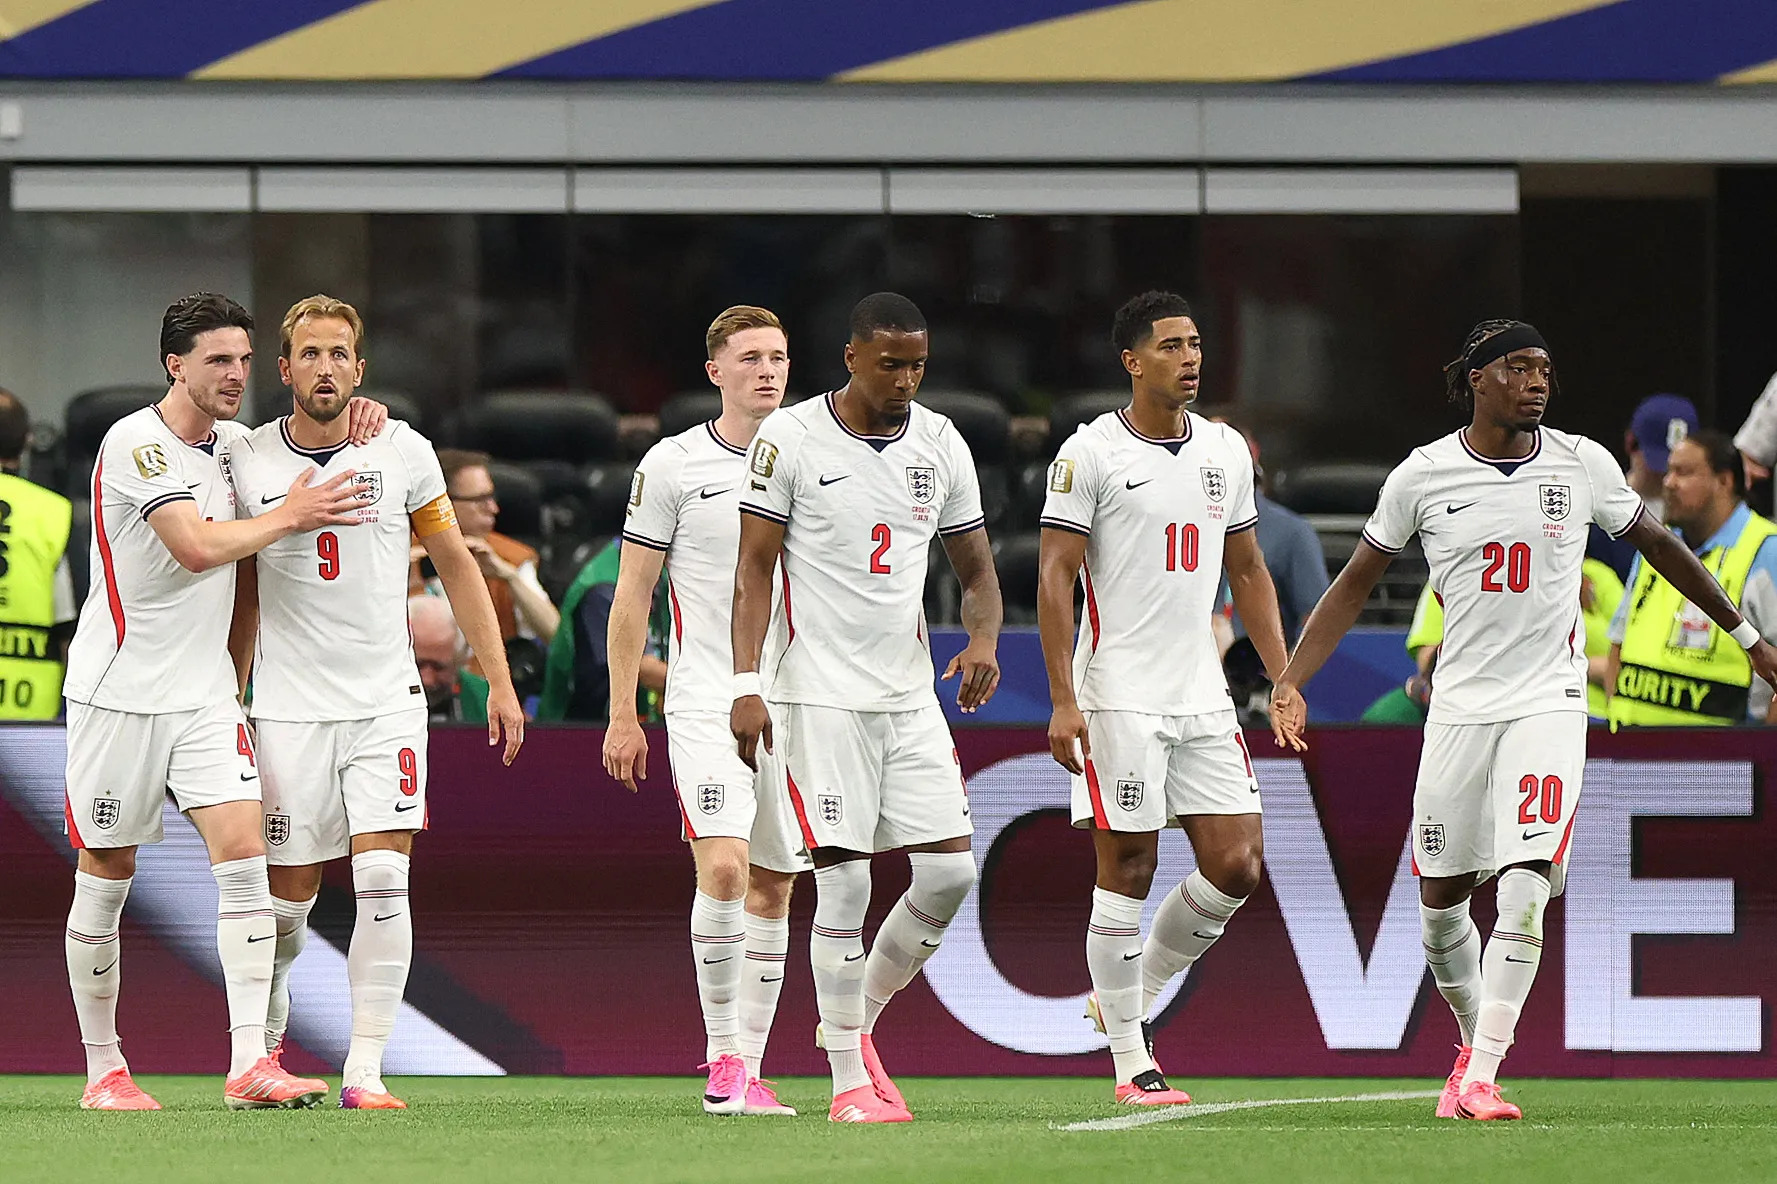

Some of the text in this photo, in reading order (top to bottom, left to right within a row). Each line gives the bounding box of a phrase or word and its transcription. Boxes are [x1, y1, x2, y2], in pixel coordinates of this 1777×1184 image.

[316, 530, 341, 581] 9
[870, 523, 892, 574] 2
[1165, 522, 1199, 572] 10
[1481, 541, 1532, 594] 20
[0, 628, 49, 657] ITY
[236, 723, 256, 768] 4
[398, 747, 418, 797] 9
[1517, 773, 1564, 825] 20
